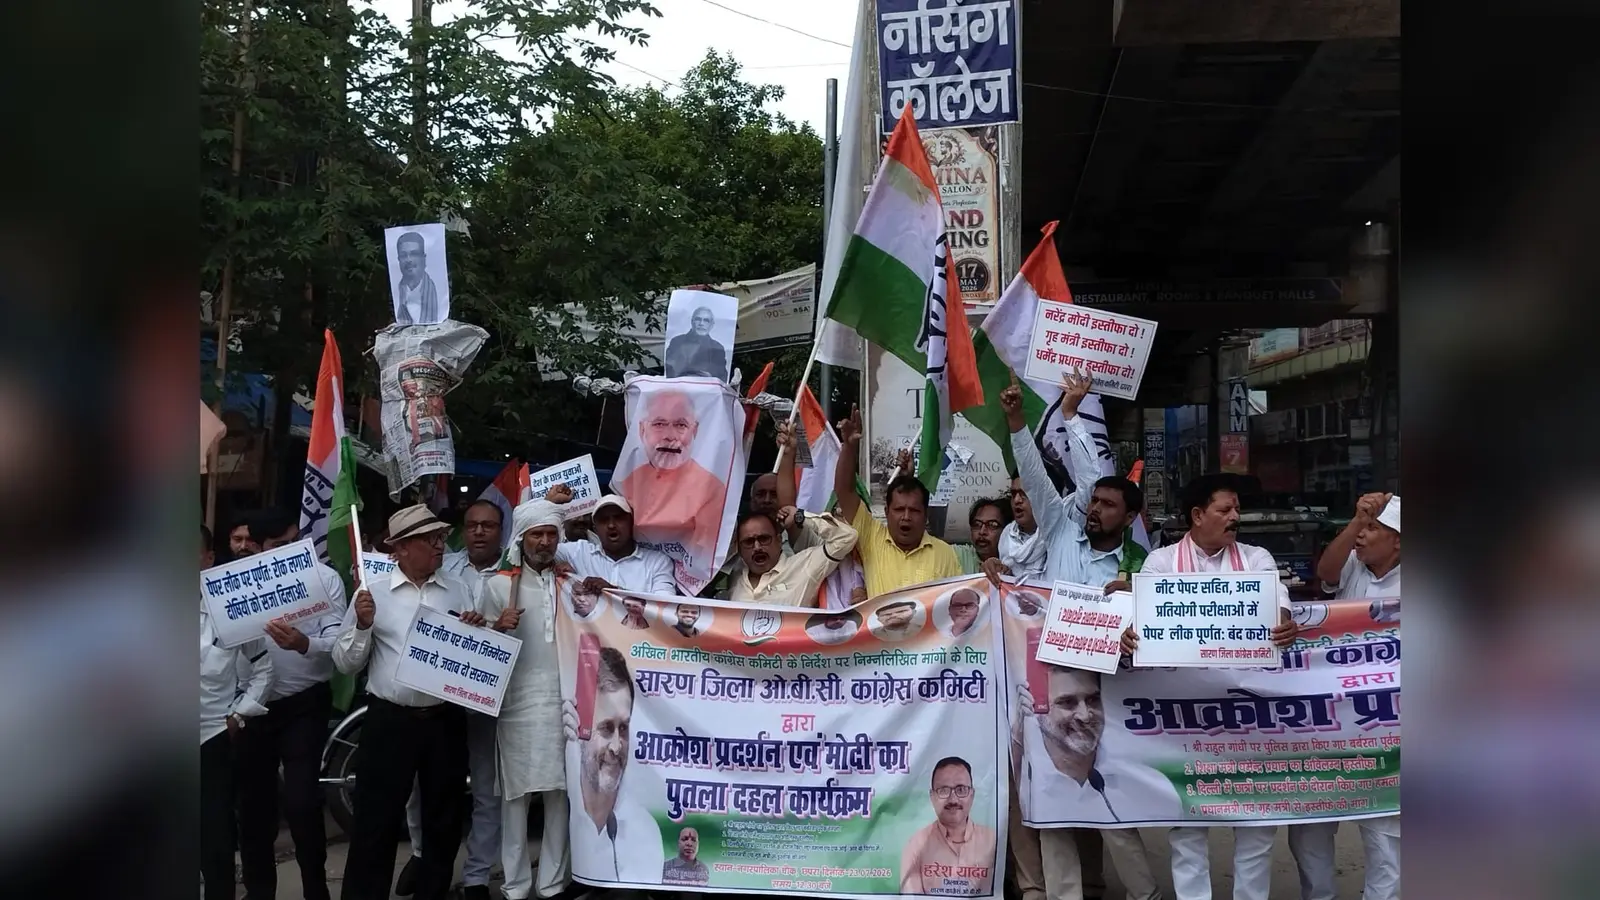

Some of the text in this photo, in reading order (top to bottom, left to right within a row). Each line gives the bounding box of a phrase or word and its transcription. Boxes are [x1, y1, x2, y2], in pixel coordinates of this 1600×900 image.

[887, 56, 1011, 122] कॉलेज
[942, 186, 972, 194] SALON
[960, 264, 978, 278] 17
[1279, 290, 1317, 300] HALLS
[1068, 312, 1090, 328] मोदी
[1091, 318, 1128, 336] इस्तीफा
[1129, 324, 1140, 338] दो
[1046, 330, 1059, 346] गृह
[1060, 332, 1080, 346] मंत्री
[1081, 338, 1118, 354] इस्तीफा
[1118, 343, 1130, 357] दो
[1086, 360, 1120, 376] इस्तीफा
[582, 474, 590, 484] से
[960, 476, 992, 487] SOON
[580, 488, 588, 498] से
[206, 576, 224, 598] पेपर
[222, 570, 242, 593] लीक
[240, 568, 253, 588] पर
[271, 556, 288, 578] रोक
[286, 547, 314, 574] लगाओ
[1155, 578, 1174, 594] नीट
[1178, 578, 1198, 594] पेपर
[1236, 580, 1261, 594] अन्य
[250, 591, 261, 614] को
[260, 589, 280, 610] सजा
[1156, 600, 1260, 618] प्रतियोगी परीक्षाओं में
[416, 618, 512, 664] पेपर लीक पर कौन जिम्मेदार
[1143, 625, 1164, 640] पेपर
[1169, 624, 1194, 640] लीक
[1227, 627, 1242, 641] बंद
[408, 645, 430, 664] जवाब
[440, 657, 460, 675] जवाब
[460, 661, 471, 678] दो
[631, 644, 988, 670] अखिल भारतीय कांग्रेस कमिटी के निर्देश पर निम्नलिखित मांगों के लिए
[1200, 648, 1252, 659] सारण जिला कांग्रेस
[635, 668, 697, 697] सारण
[699, 667, 754, 701] जिला
[850, 670, 914, 706] कांग्रेस
[917, 668, 988, 702] कमिटी
[1336, 672, 1396, 688] द्वारा
[1123, 688, 1334, 733] आक्रोश
[781, 713, 816, 734] द्वारा
[634, 726, 911, 773] आक्रोश प्रदर्शन एवं मोदी का
[1192, 740, 1203, 752] श्री
[1204, 743, 1226, 756] राहुल
[1228, 739, 1248, 752] गांधी
[1249, 742, 1262, 752] पर
[1263, 738, 1288, 756] पुलिस
[1290, 742, 1309, 752] द्वारा
[1312, 738, 1330, 751] किए
[1332, 740, 1346, 750] गए
[1184, 763, 1194, 776] 2.
[1195, 760, 1217, 774] शिक्षा
[1264, 760, 1288, 774] प्रधान
[1289, 759, 1302, 772] का
[1342, 754, 1376, 774] इस्तीफा
[1186, 784, 1196, 796] 3.
[1196, 778, 1222, 796] दिल्ली
[1255, 781, 1268, 794] पर
[1269, 776, 1298, 793] प्रदर्शन
[1298, 776, 1308, 792] के
[1309, 776, 1335, 792] दौरान
[1336, 775, 1356, 792] किए
[1357, 780, 1373, 790] गए
[666, 777, 873, 820] पुतला दहल कार्यक्रम
[1258, 803, 1272, 816] गृह
[1292, 797, 1302, 812] से
[1303, 797, 1335, 815] इस्तीफे
[1336, 796, 1347, 810] की
[924, 862, 989, 878] हरेश यादव
